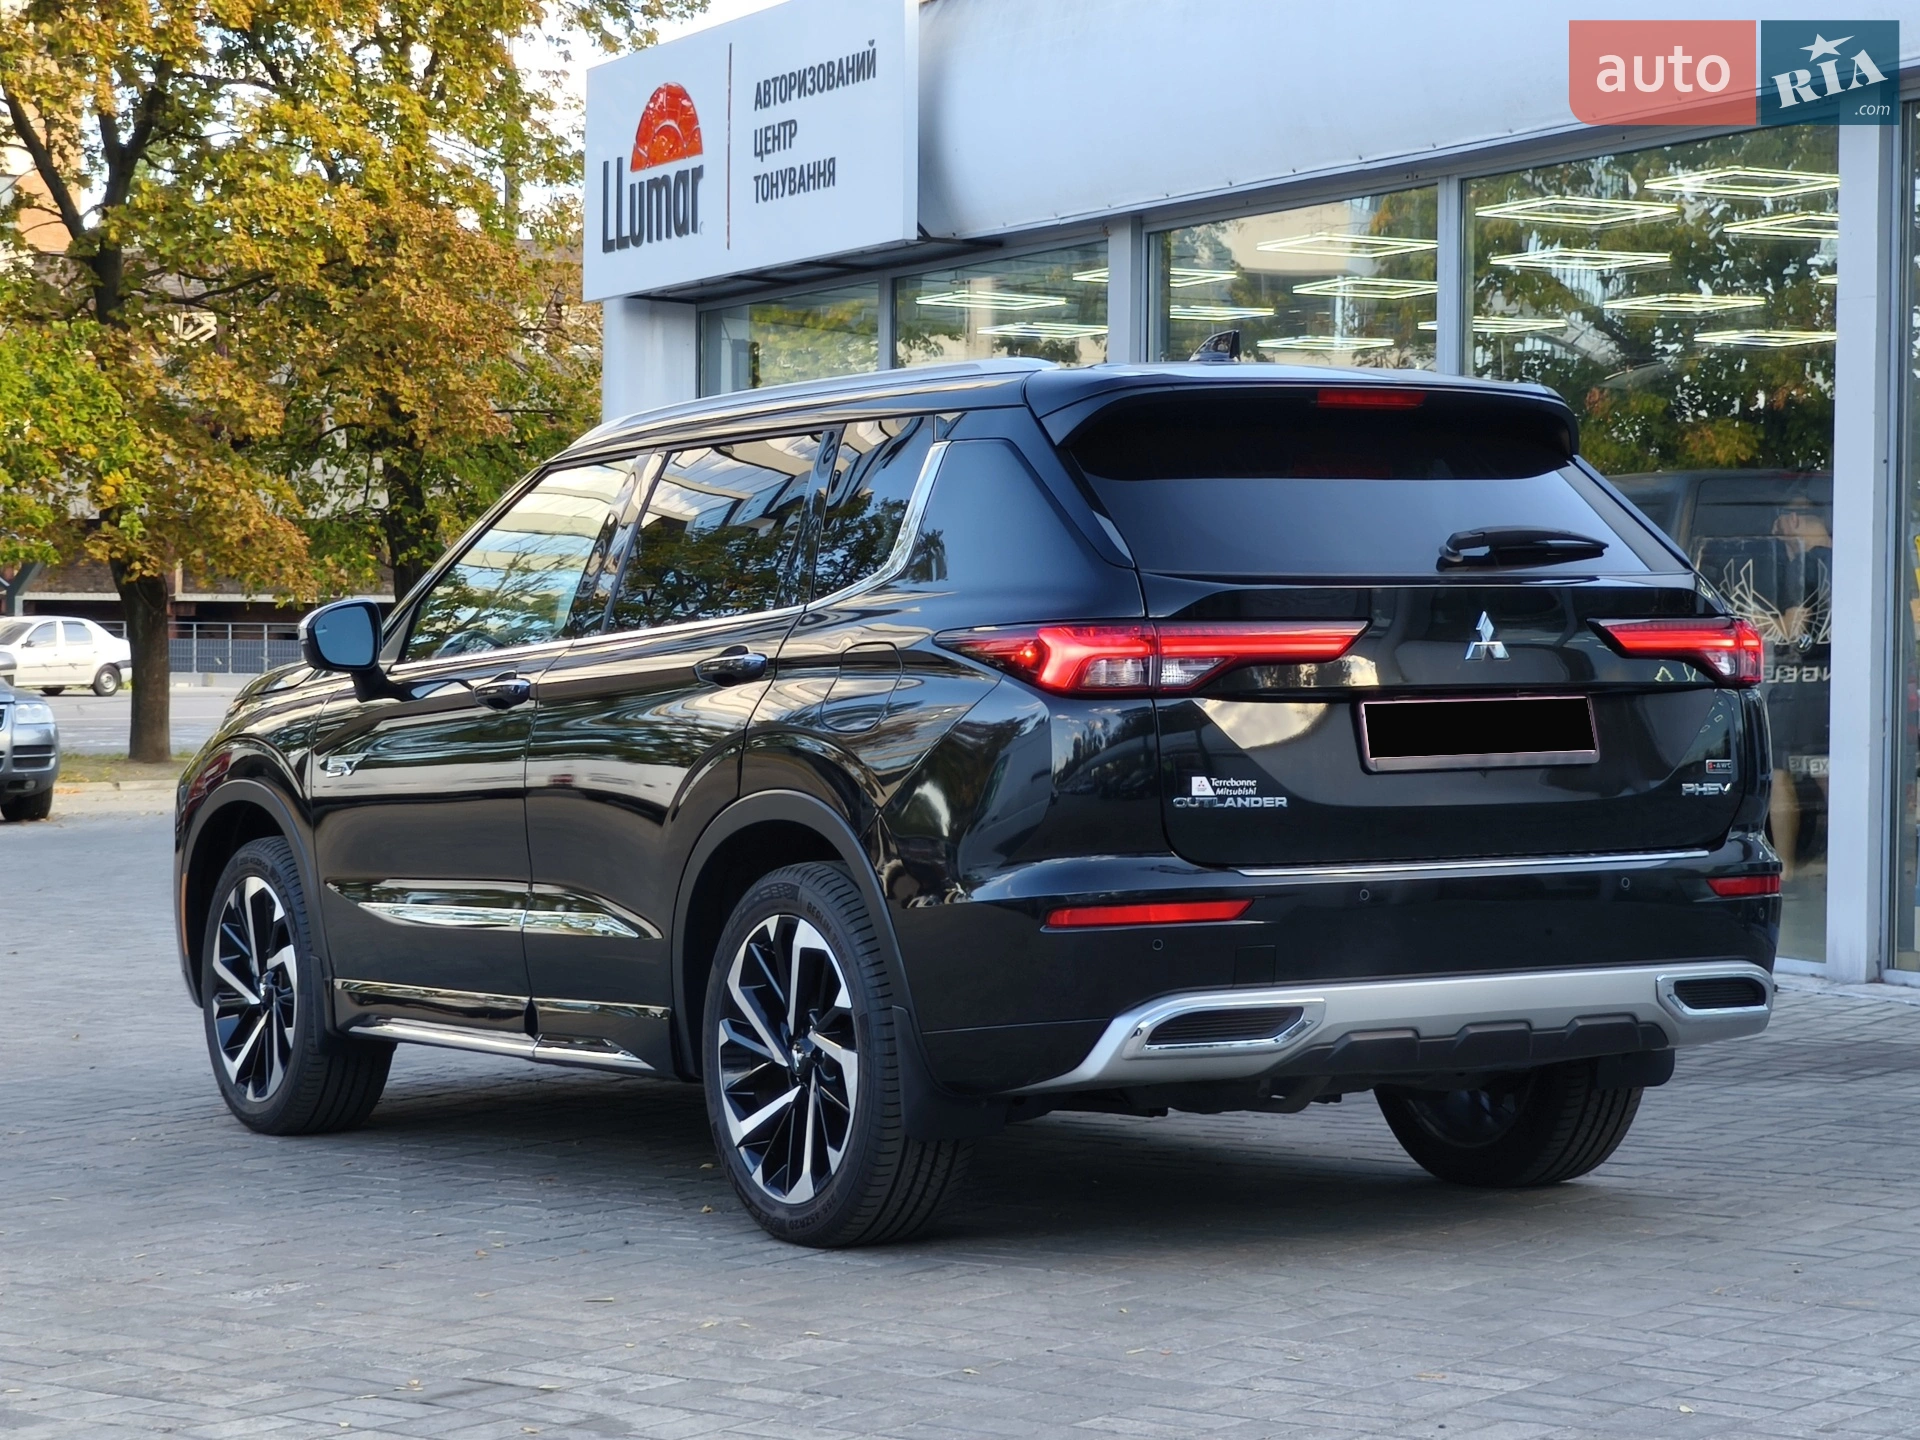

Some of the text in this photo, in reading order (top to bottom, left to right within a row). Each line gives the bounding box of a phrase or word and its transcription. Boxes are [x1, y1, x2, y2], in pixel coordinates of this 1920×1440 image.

[754, 39, 877, 111] АВТОРИЗОВАНИЙ
[753, 119, 798, 162] ЦЕНТР
[753, 157, 836, 204] ТОНУВАННЯ
[602, 156, 704, 254] LLumar
[1210, 777, 1257, 787] Terrebonne
[1215, 787, 1257, 796] Mitsubishi
[1682, 783, 1732, 796] PHEV
[1173, 796, 1288, 808] OUTLANDER
